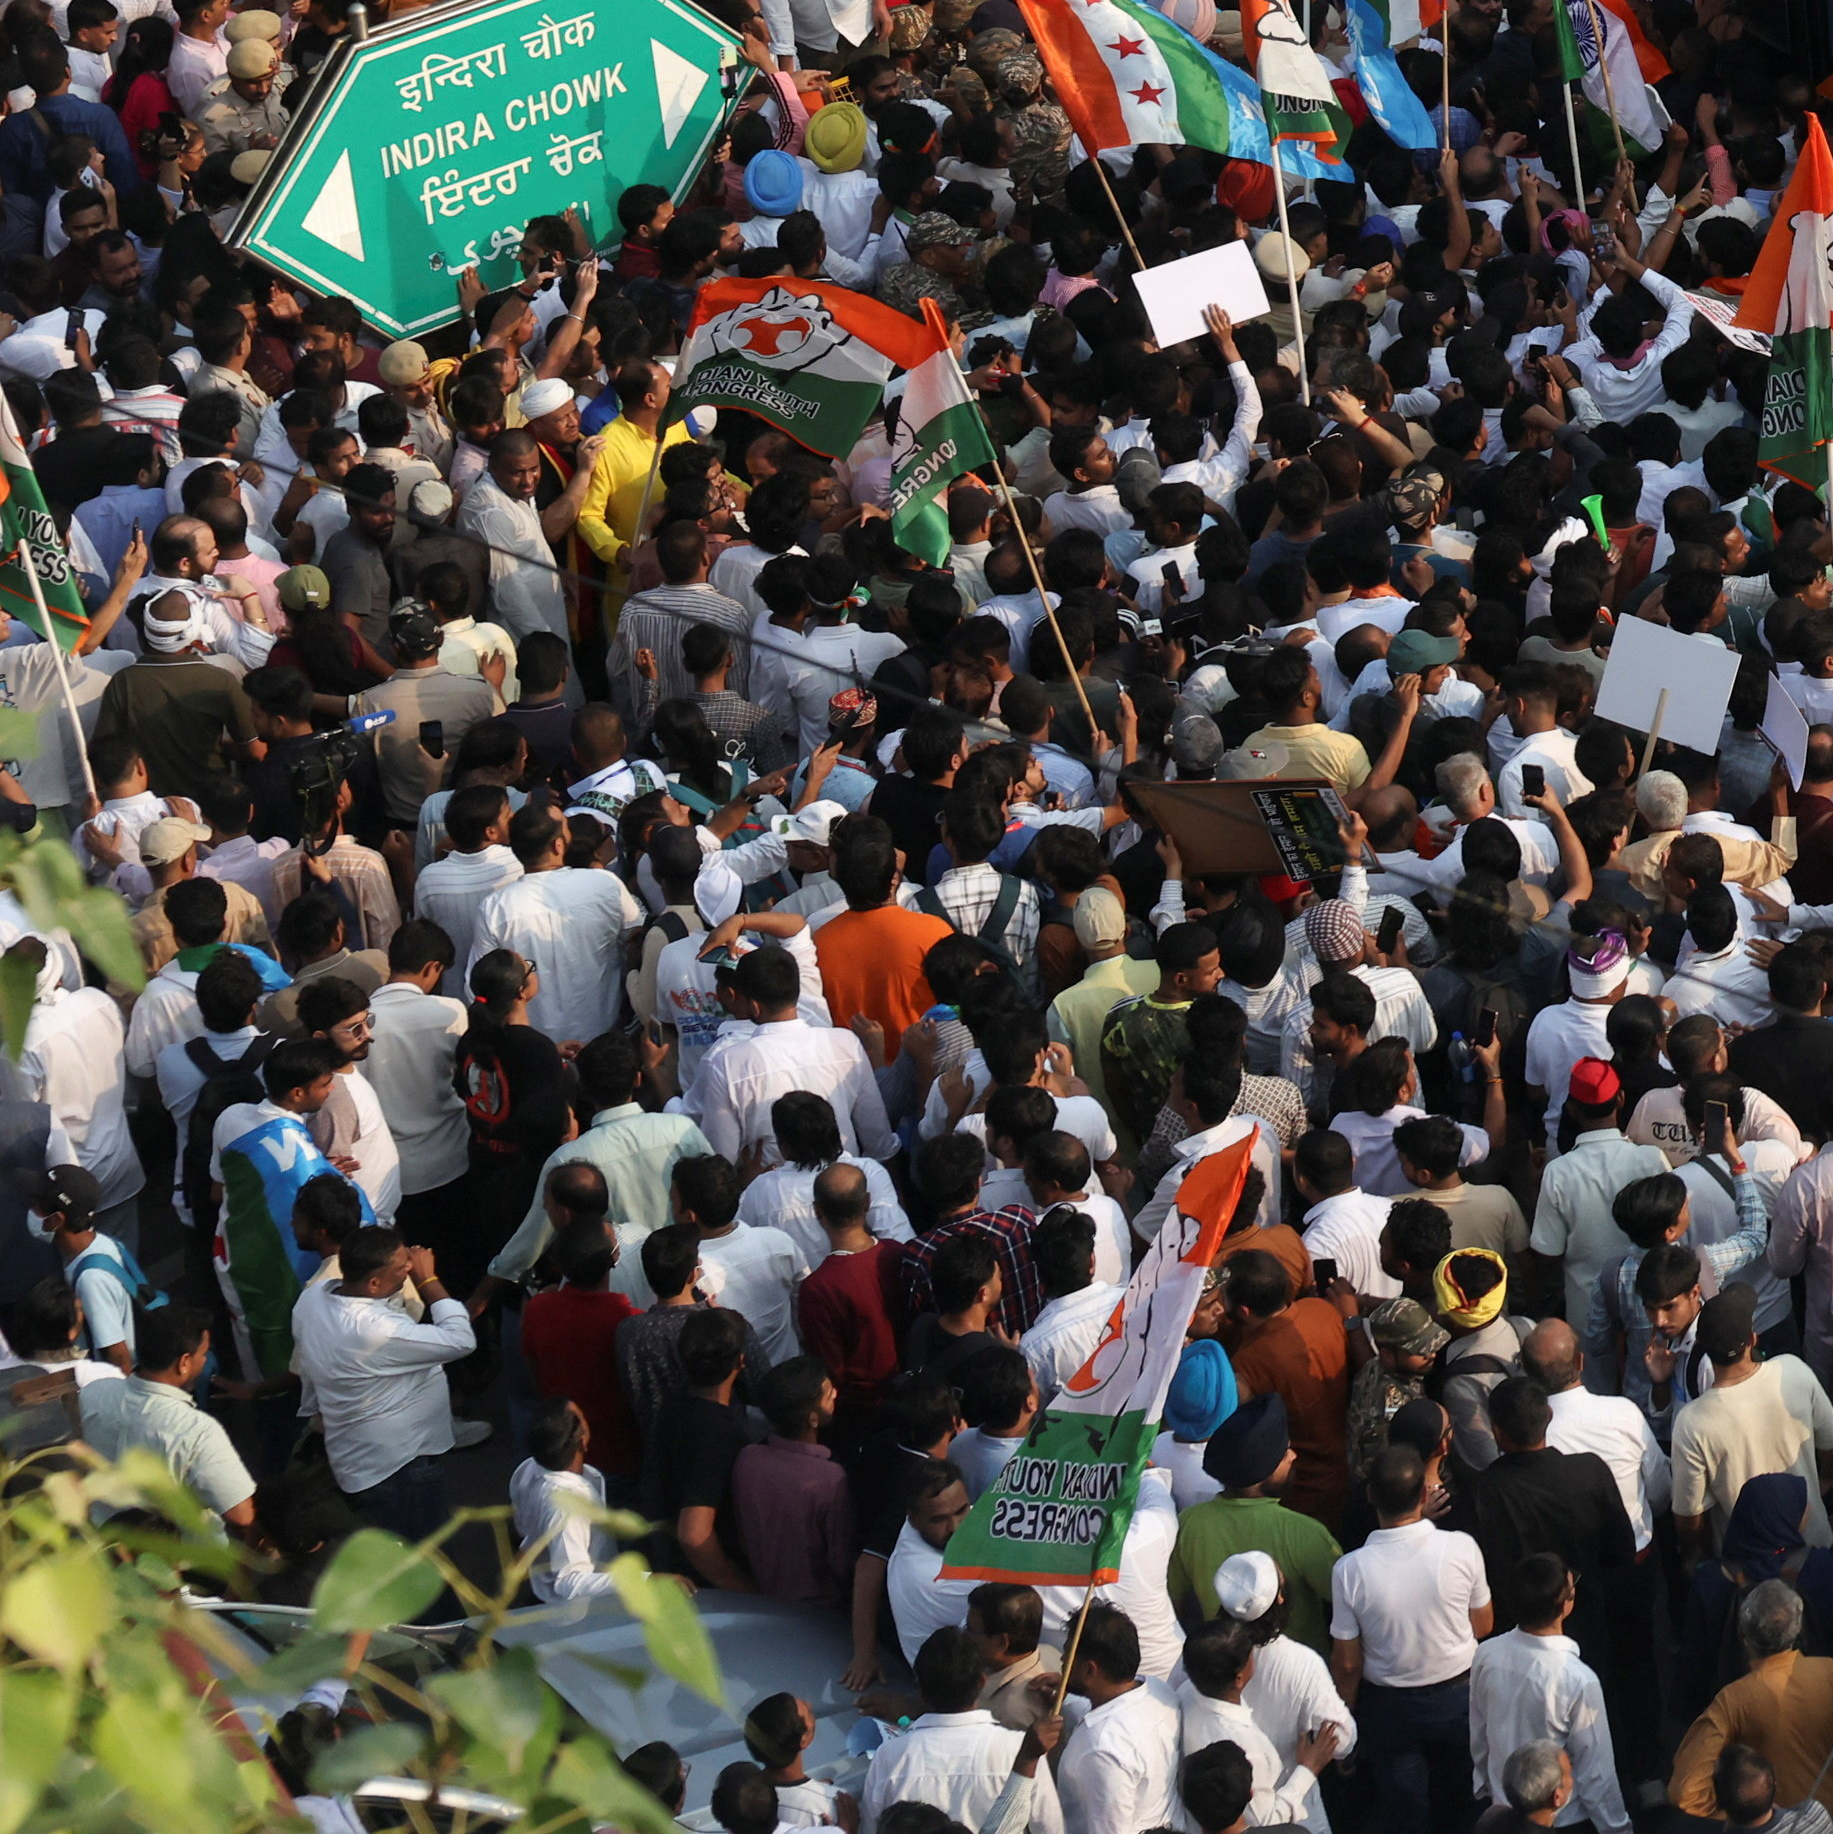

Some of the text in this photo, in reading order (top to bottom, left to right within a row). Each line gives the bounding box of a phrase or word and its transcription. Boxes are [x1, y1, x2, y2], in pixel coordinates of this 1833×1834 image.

[395, 11, 595, 112] इन्दिरा चौक
[380, 62, 628, 178] INDIRA CHOWK
[757, 371, 821, 418] YOUTH
